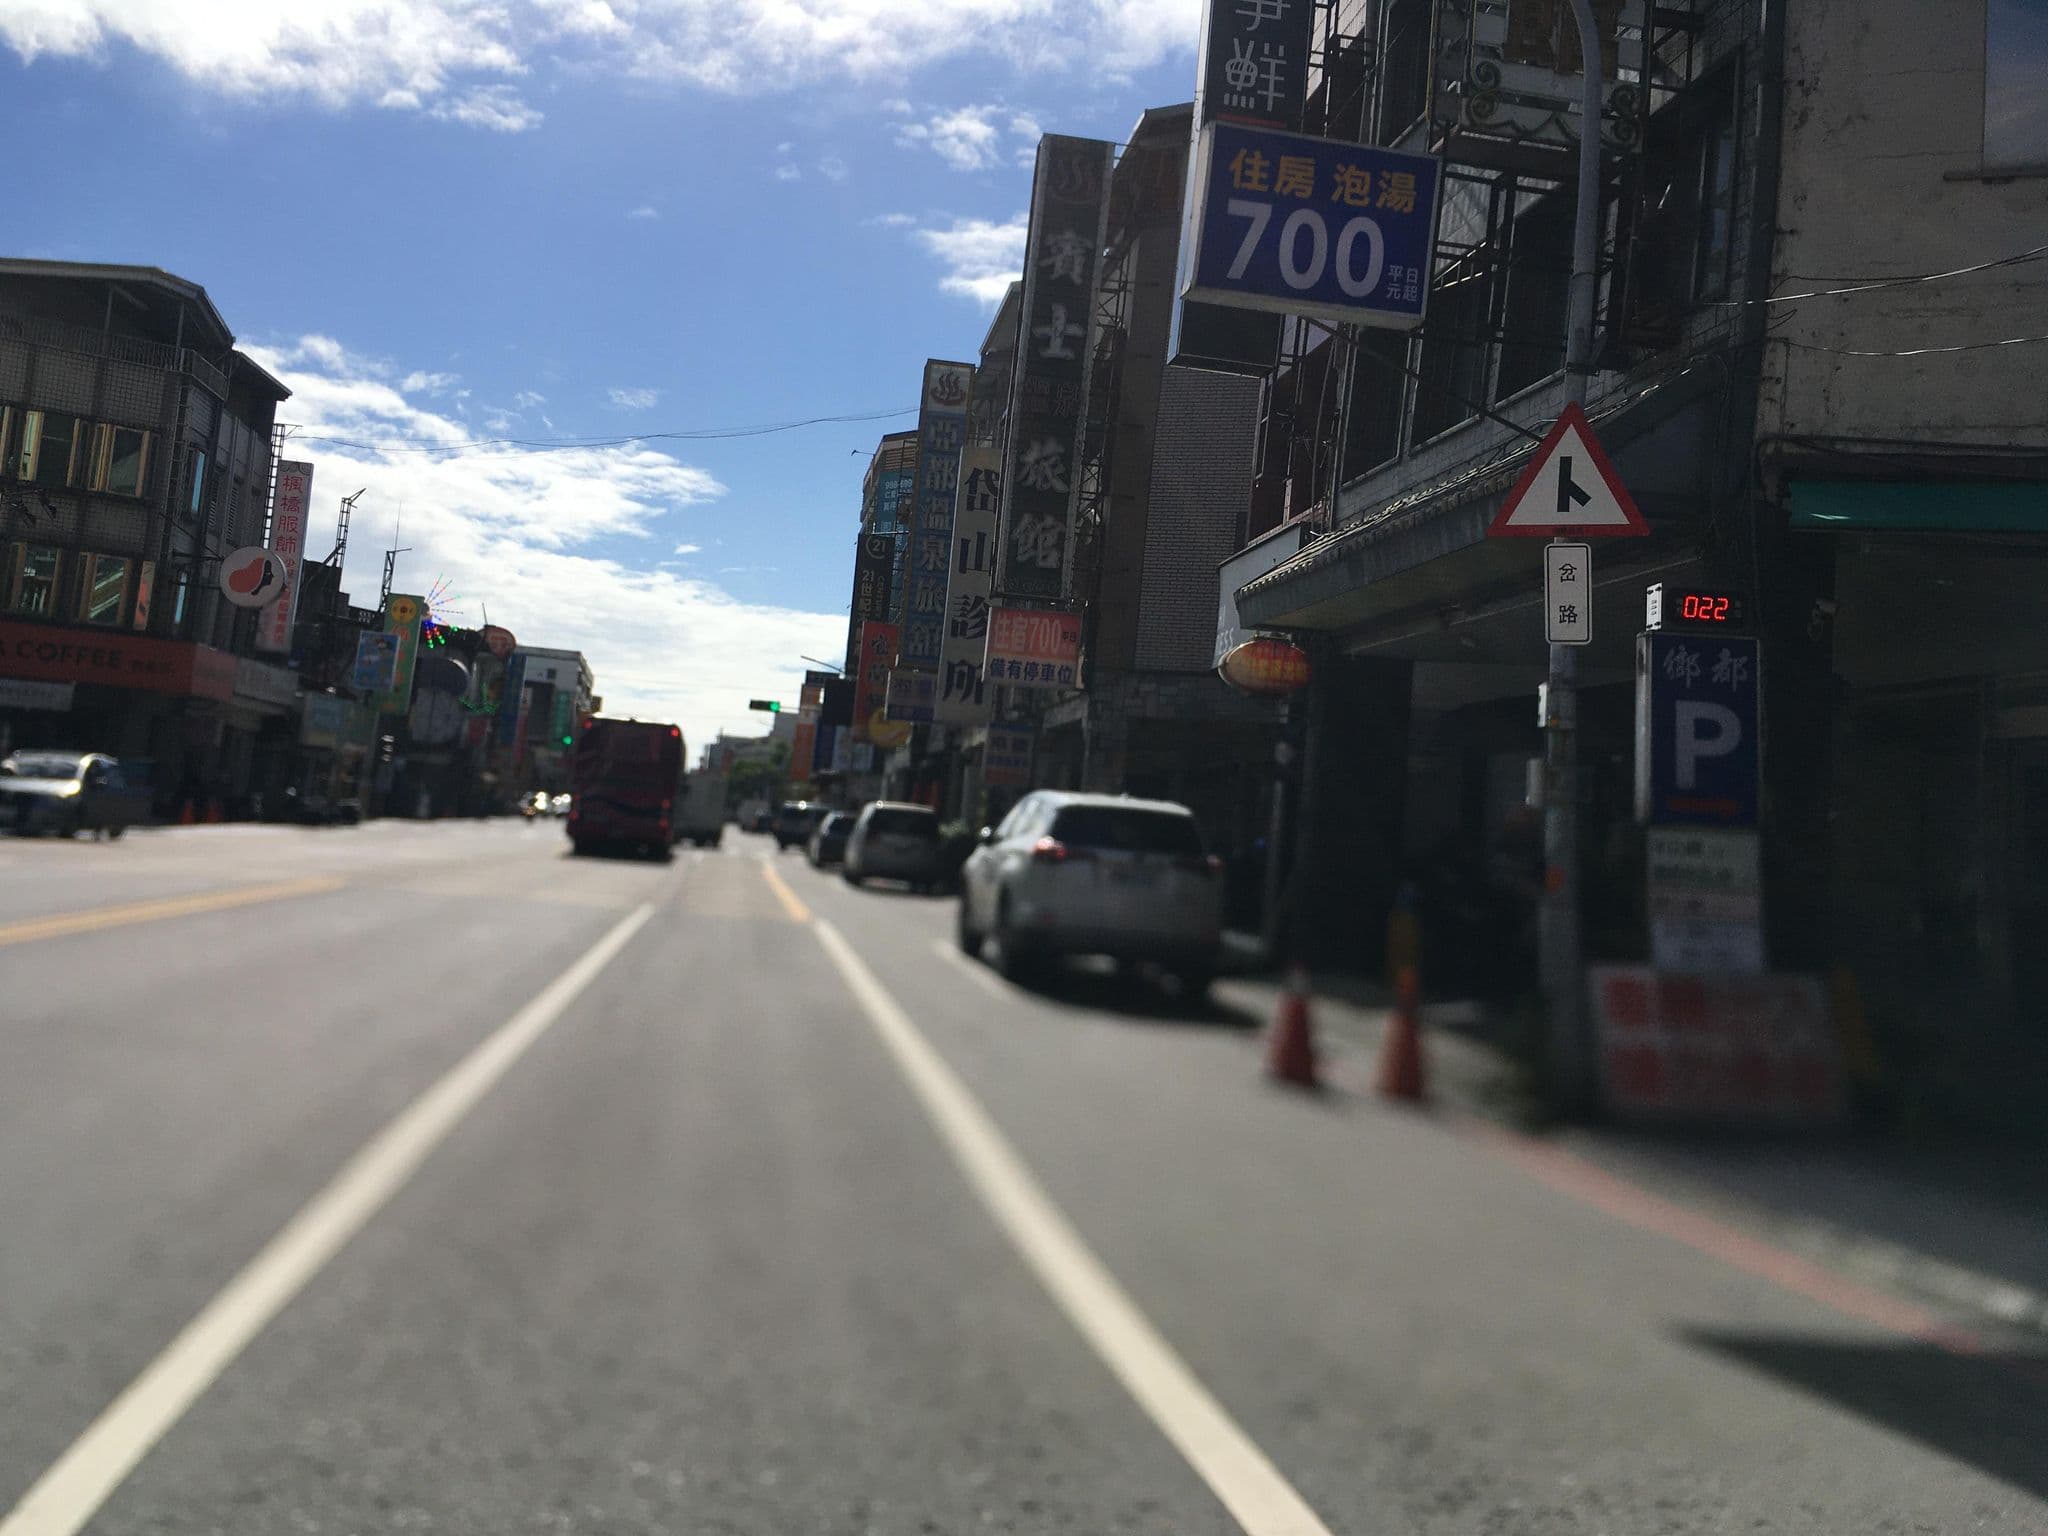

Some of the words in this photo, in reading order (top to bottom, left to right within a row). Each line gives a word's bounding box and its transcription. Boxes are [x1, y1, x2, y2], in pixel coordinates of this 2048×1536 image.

[1228, 147, 1316, 200] 住房
[1331, 162, 1417, 215] 泡湯
[1226, 197, 1385, 298] 700
[1558, 563, 1578, 624] 岔路
[1682, 596, 1729, 620] 022
[16, 639, 123, 668] COFFEE
[990, 658, 1073, 684] 備有停車位
[1675, 699, 1742, 790] P
